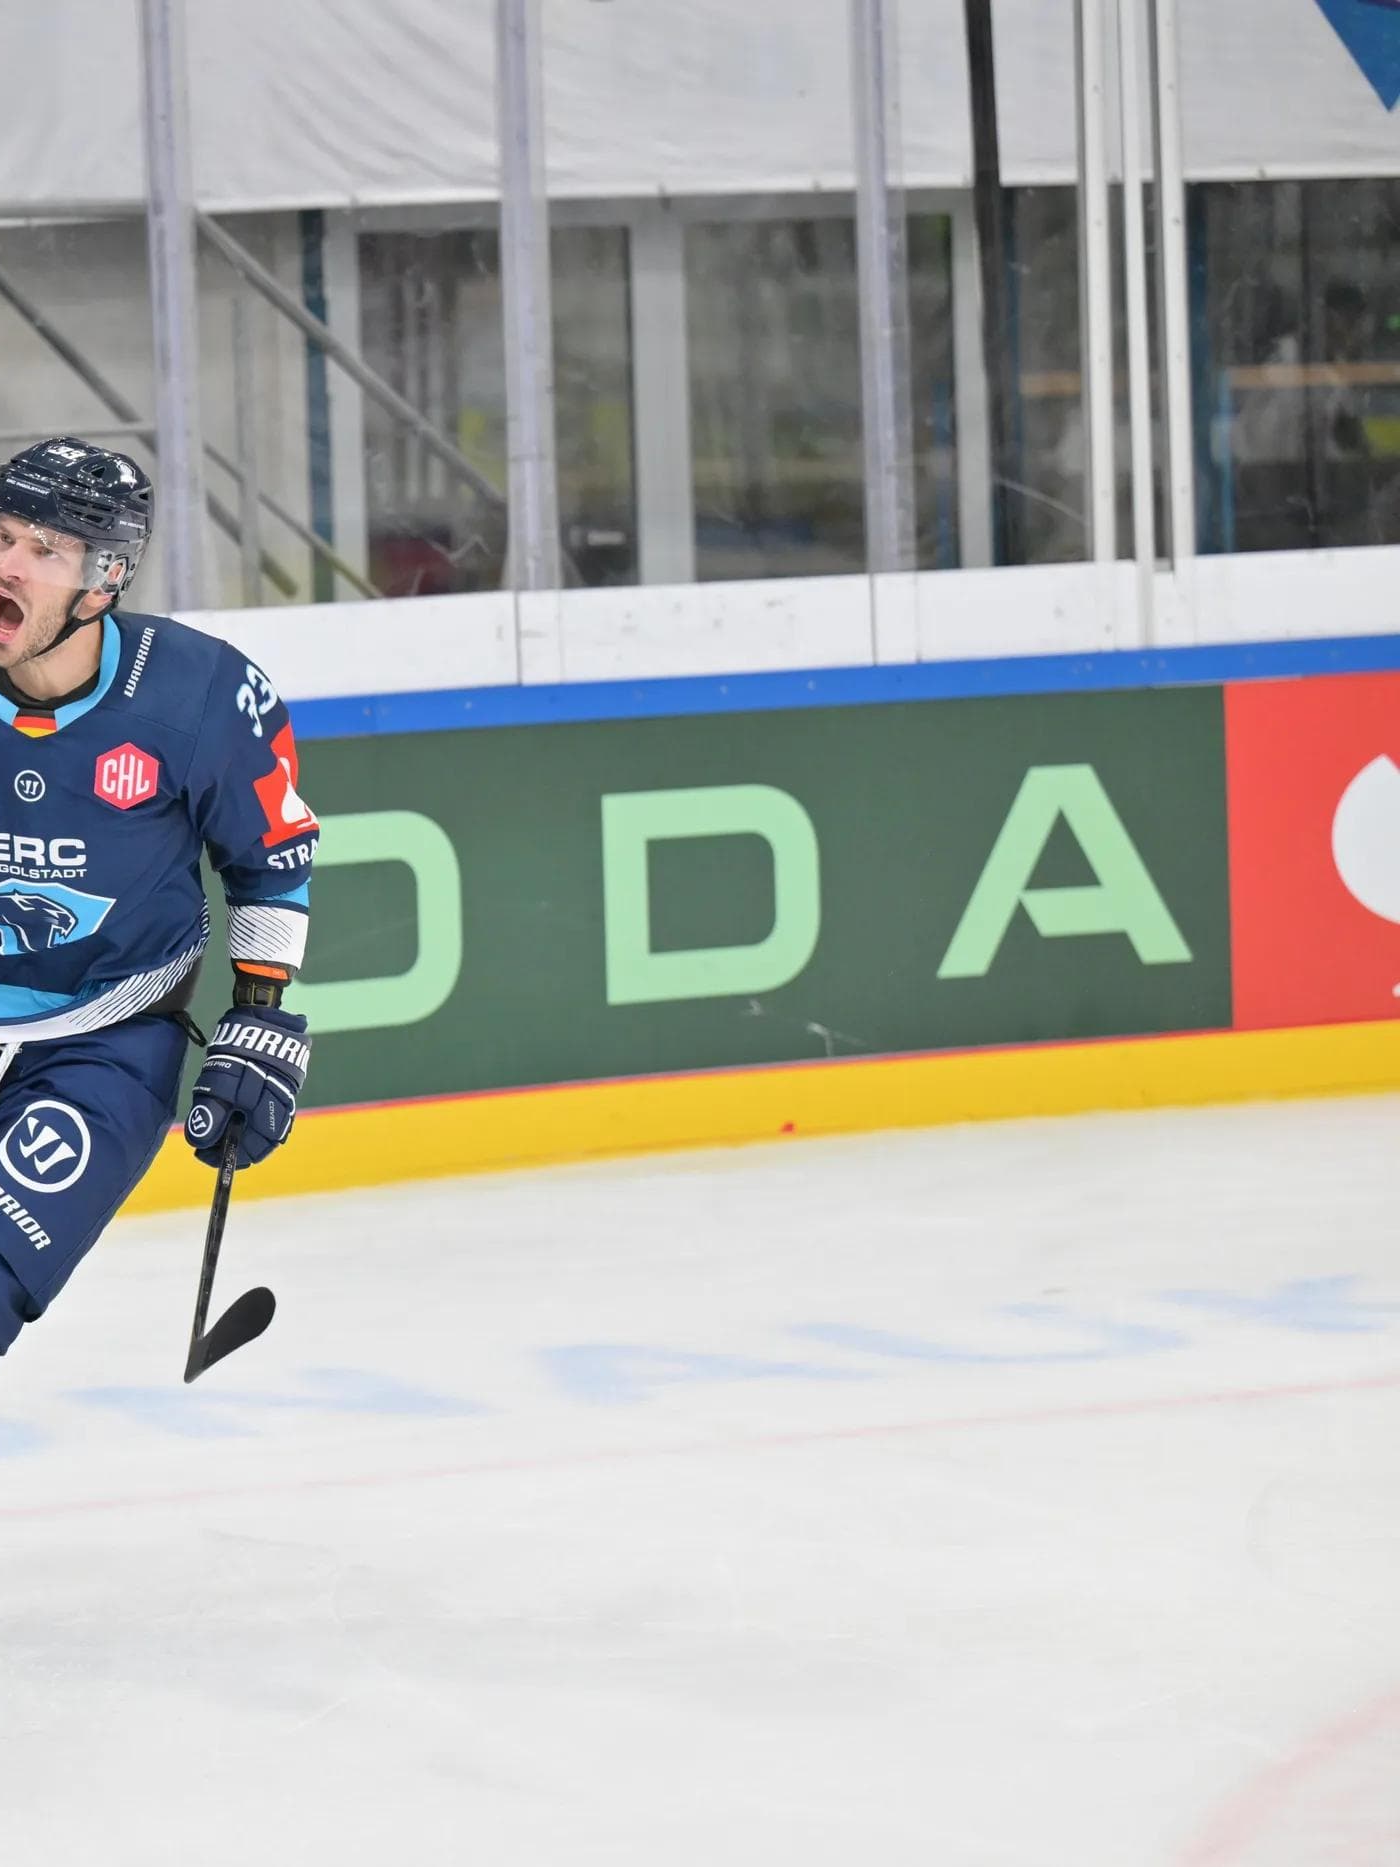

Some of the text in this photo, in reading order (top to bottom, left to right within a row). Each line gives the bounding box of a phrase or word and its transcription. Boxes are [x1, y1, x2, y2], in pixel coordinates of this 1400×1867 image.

[123, 627, 156, 698] WARRIOR
[102, 753, 150, 801] CHL
[268, 1100, 276, 1133] COVERT
